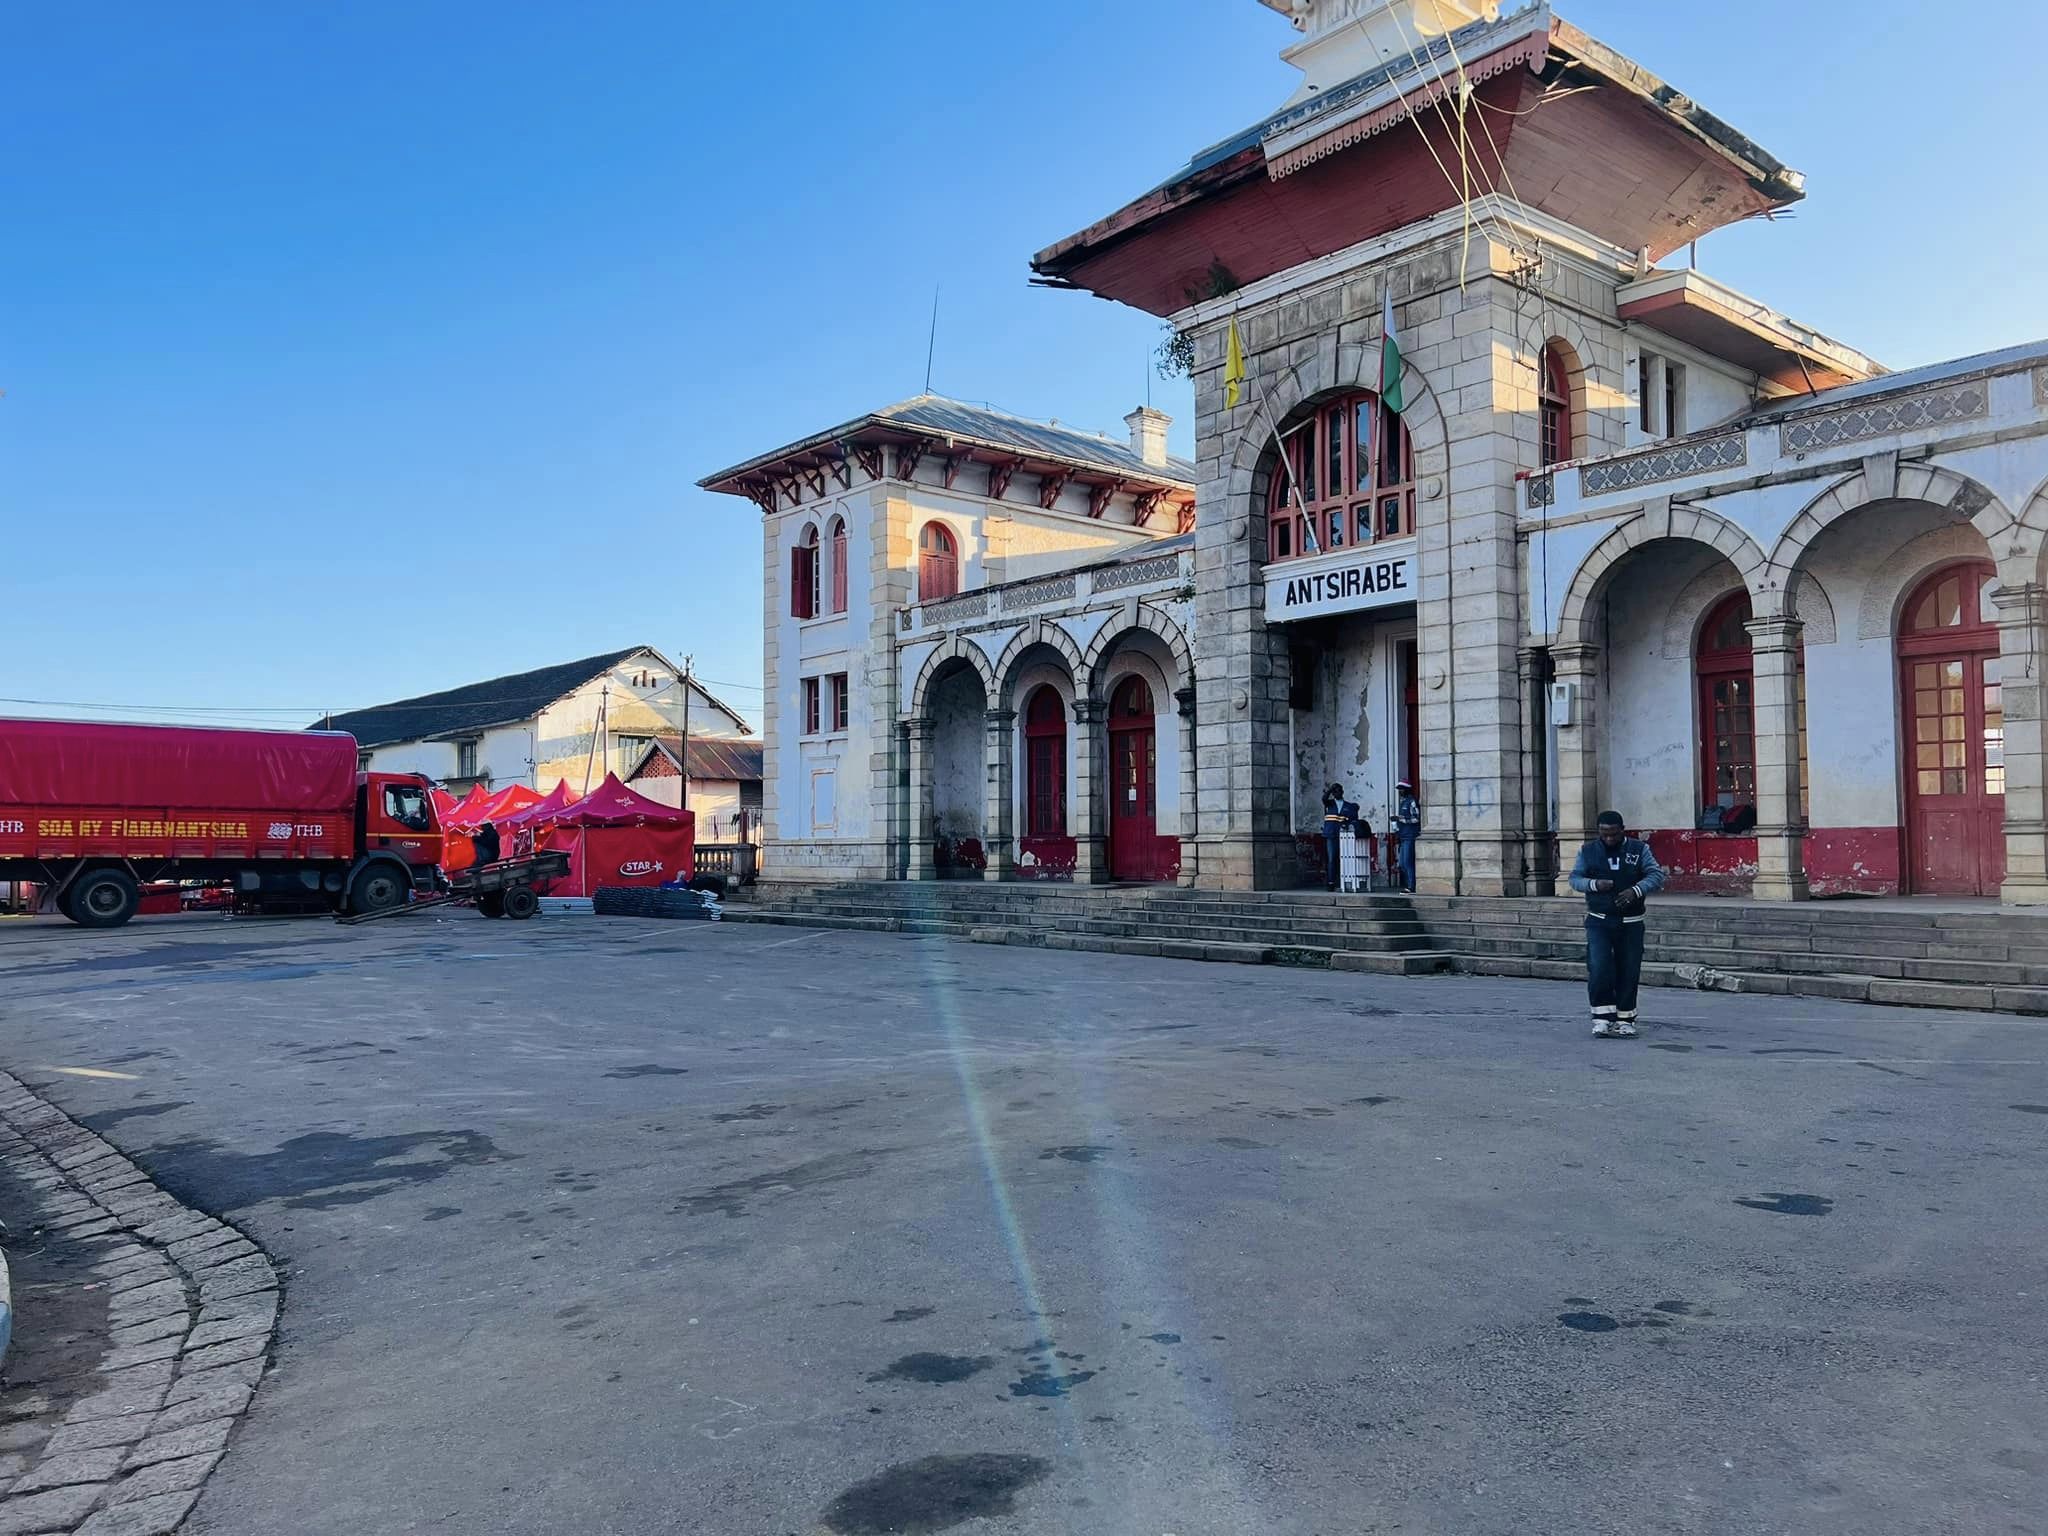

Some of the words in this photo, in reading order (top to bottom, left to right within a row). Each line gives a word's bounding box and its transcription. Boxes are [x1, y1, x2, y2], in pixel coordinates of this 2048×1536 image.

[1285, 560, 1408, 606] ANTSIRABE
[38, 820, 74, 836] SOA
[294, 824, 323, 837] THB
[626, 861, 651, 871] STAR
